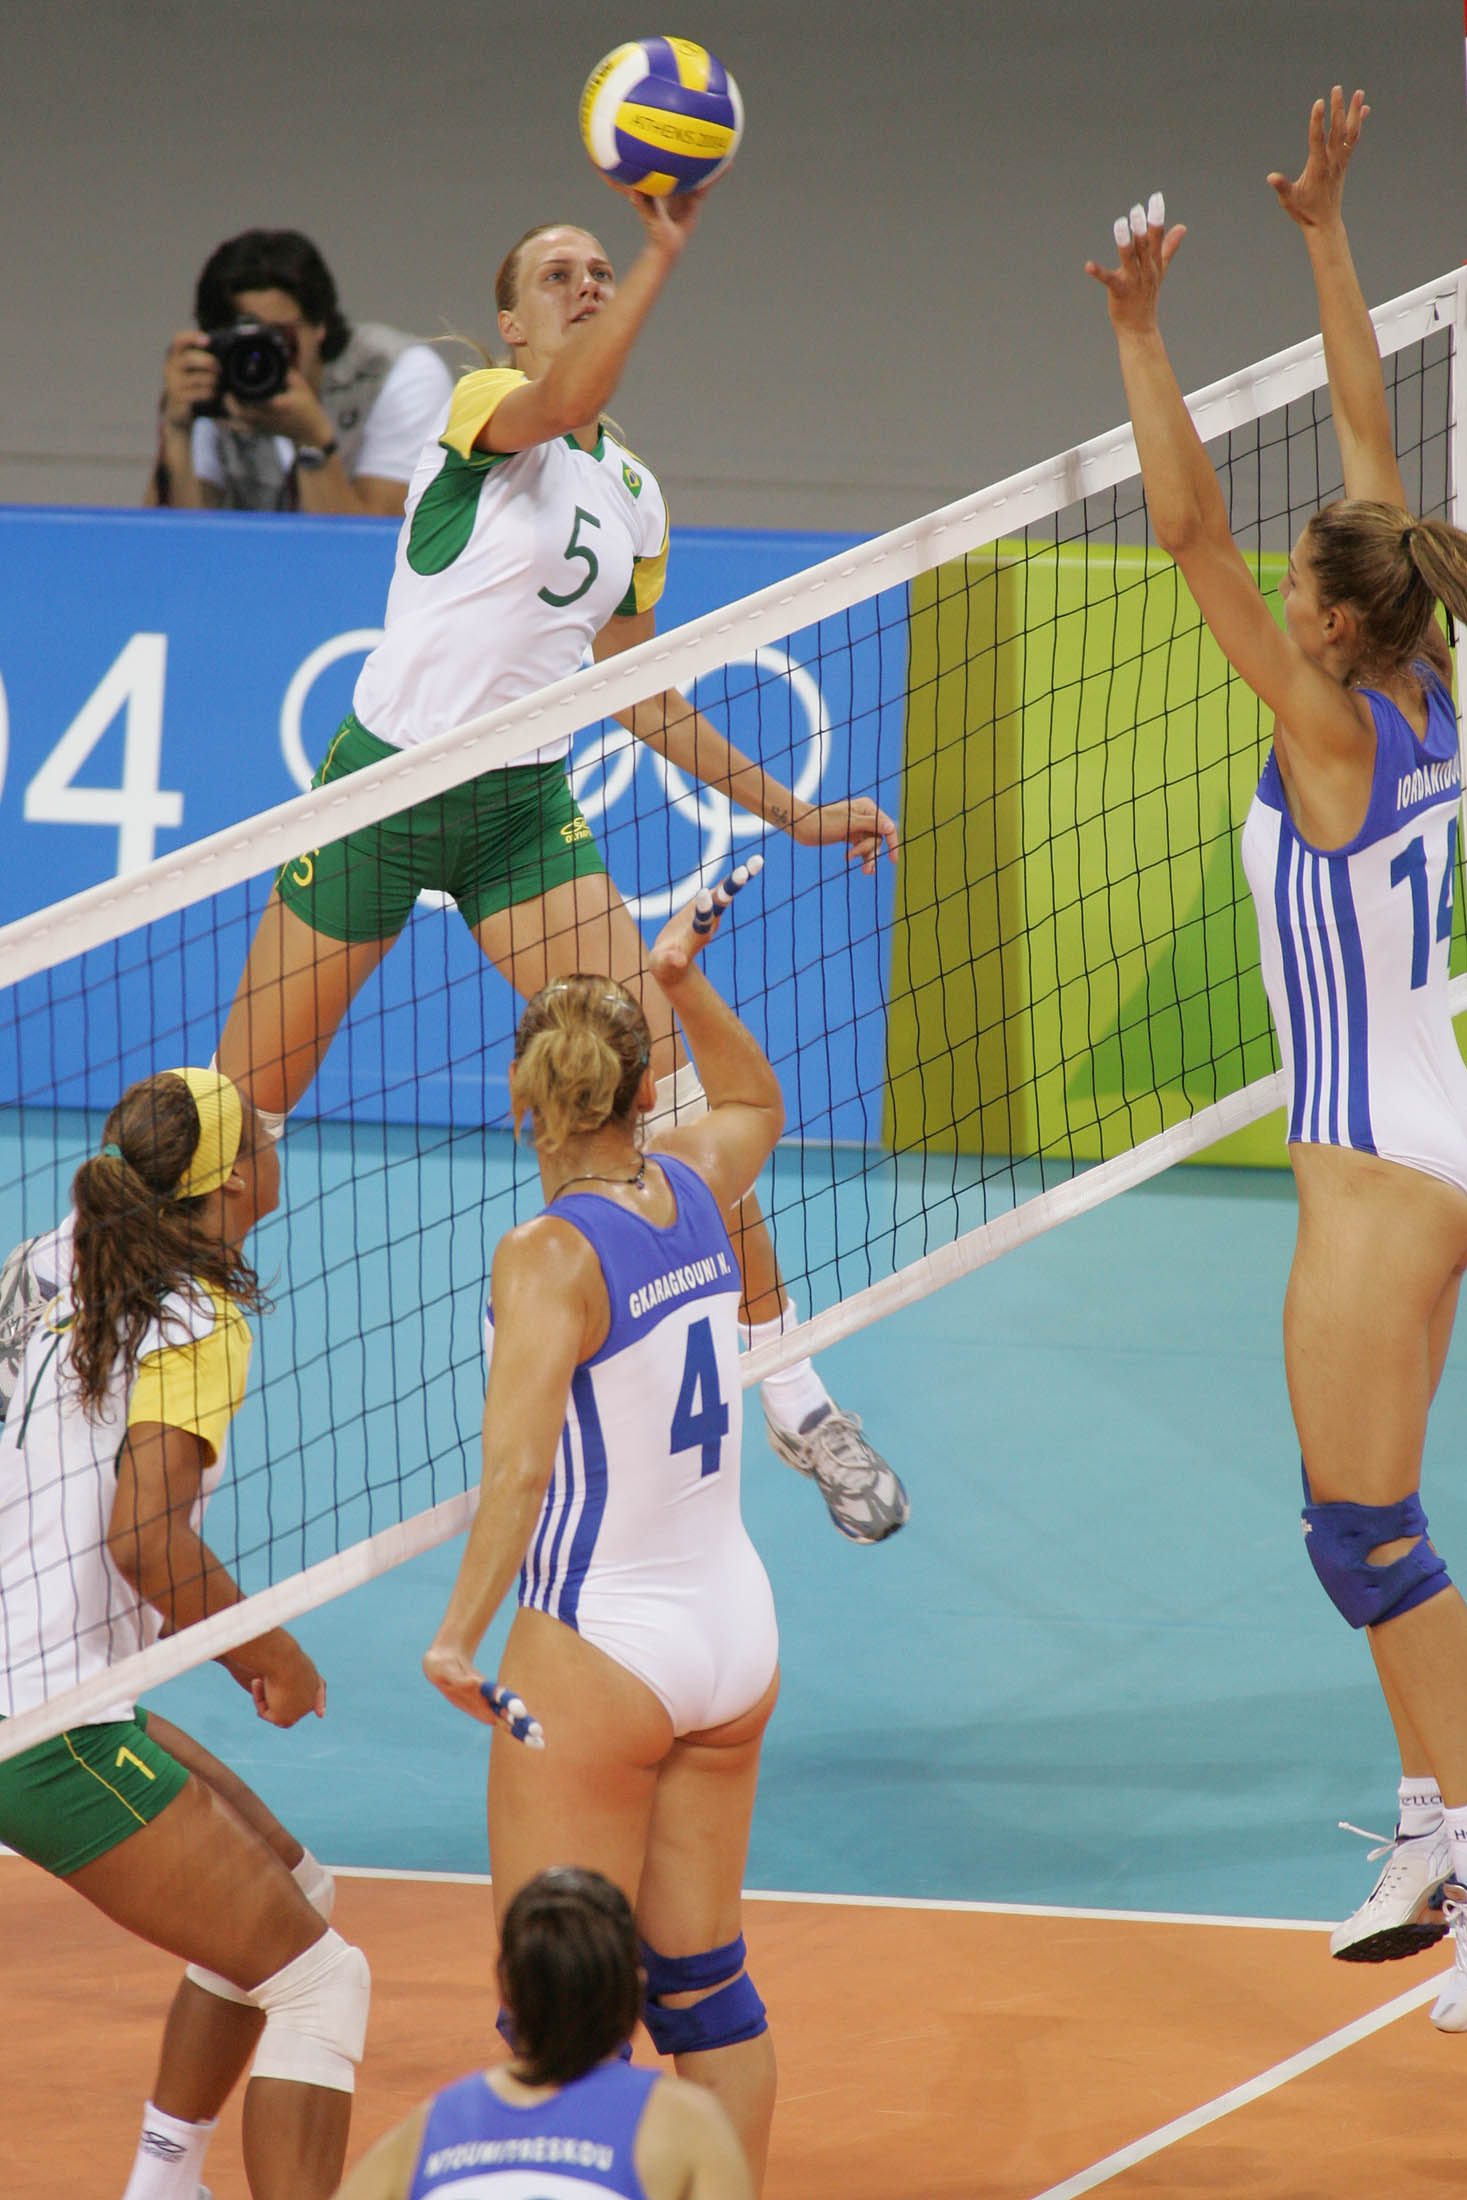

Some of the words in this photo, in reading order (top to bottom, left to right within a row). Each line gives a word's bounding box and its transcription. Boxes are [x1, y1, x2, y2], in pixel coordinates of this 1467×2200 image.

[537, 504, 602, 608] 5
[0, 631, 184, 876] 4
[1390, 816, 1457, 991] 14
[629, 1256, 717, 1319] GKARAGKOUNI
[716, 1252, 731, 1275] N.
[670, 1316, 729, 1478] 4
[116, 1746, 156, 1781] 1
